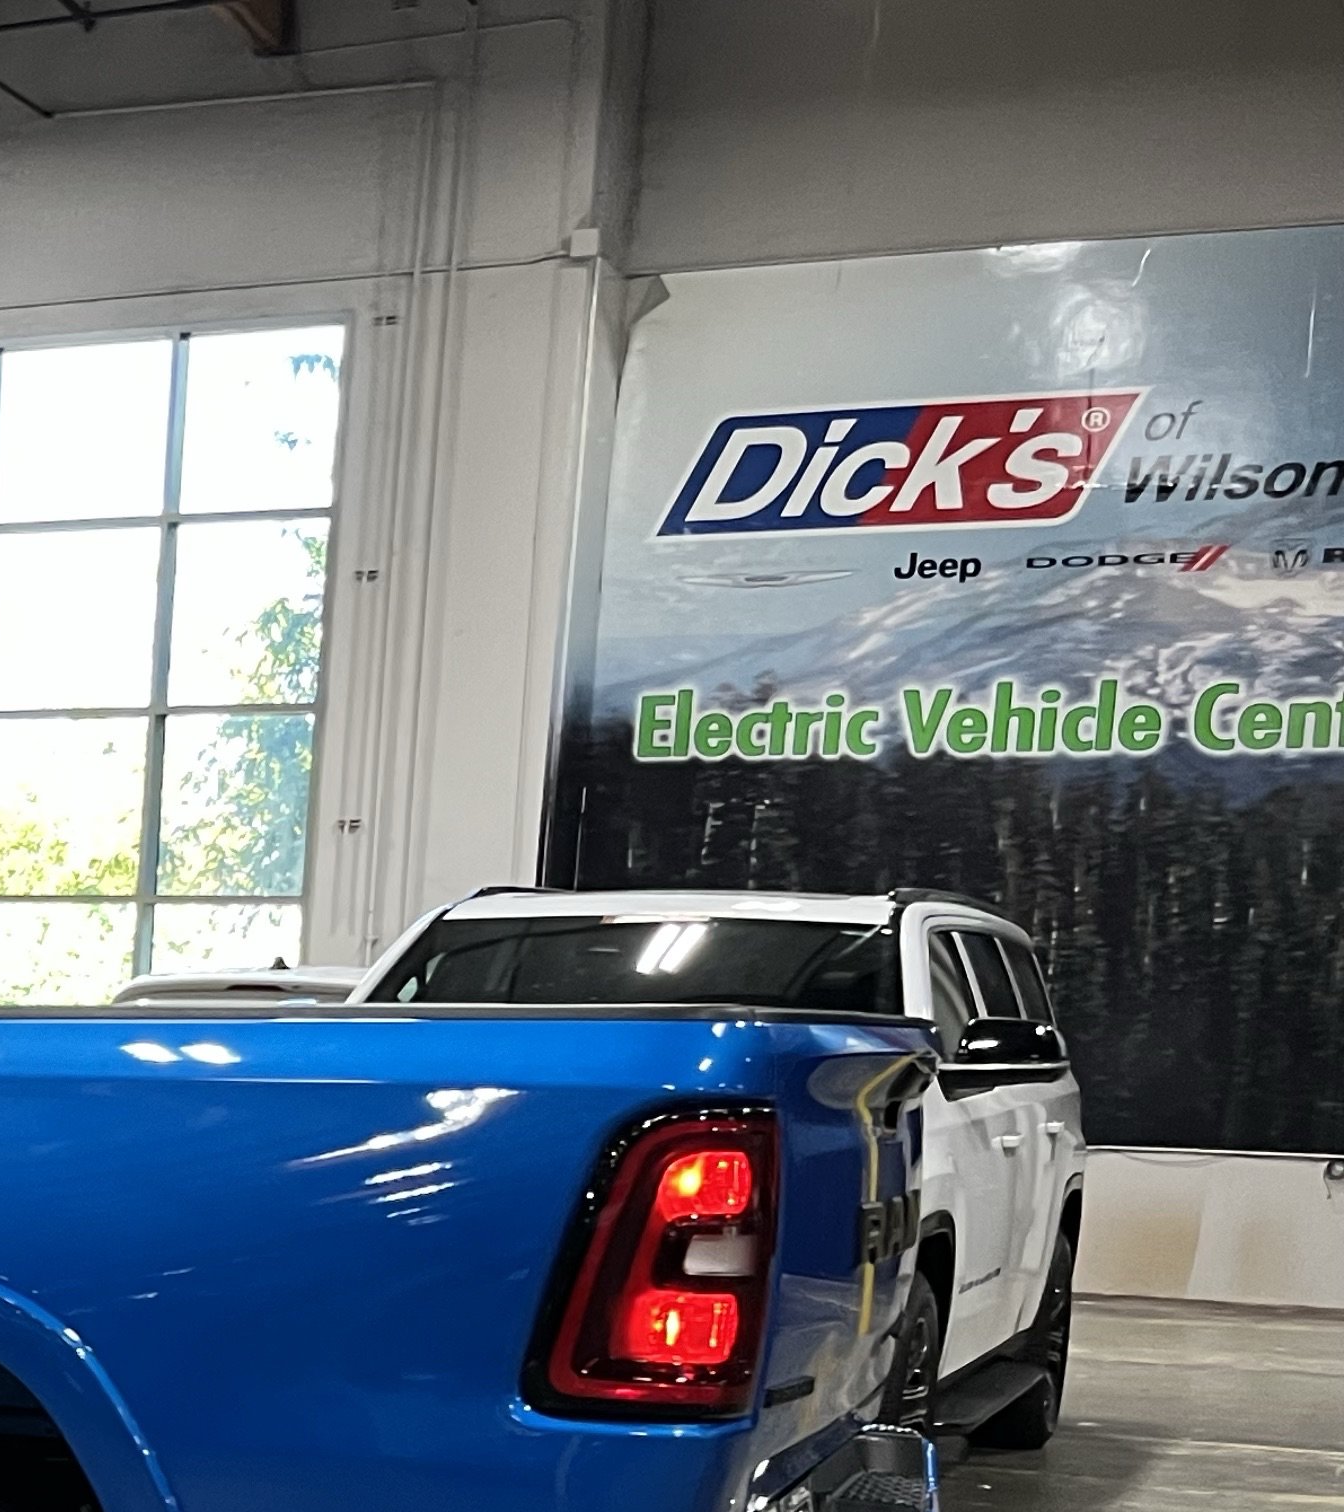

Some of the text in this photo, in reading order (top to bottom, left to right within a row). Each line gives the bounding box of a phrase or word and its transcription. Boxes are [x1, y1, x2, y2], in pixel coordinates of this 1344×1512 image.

[684, 400, 1205, 523] Dick's of
[894, 552, 982, 582] Jeep
[1026, 551, 1198, 569] DODGE
[637, 689, 879, 758] Electric
[904, 679, 1161, 754] Vehicle
